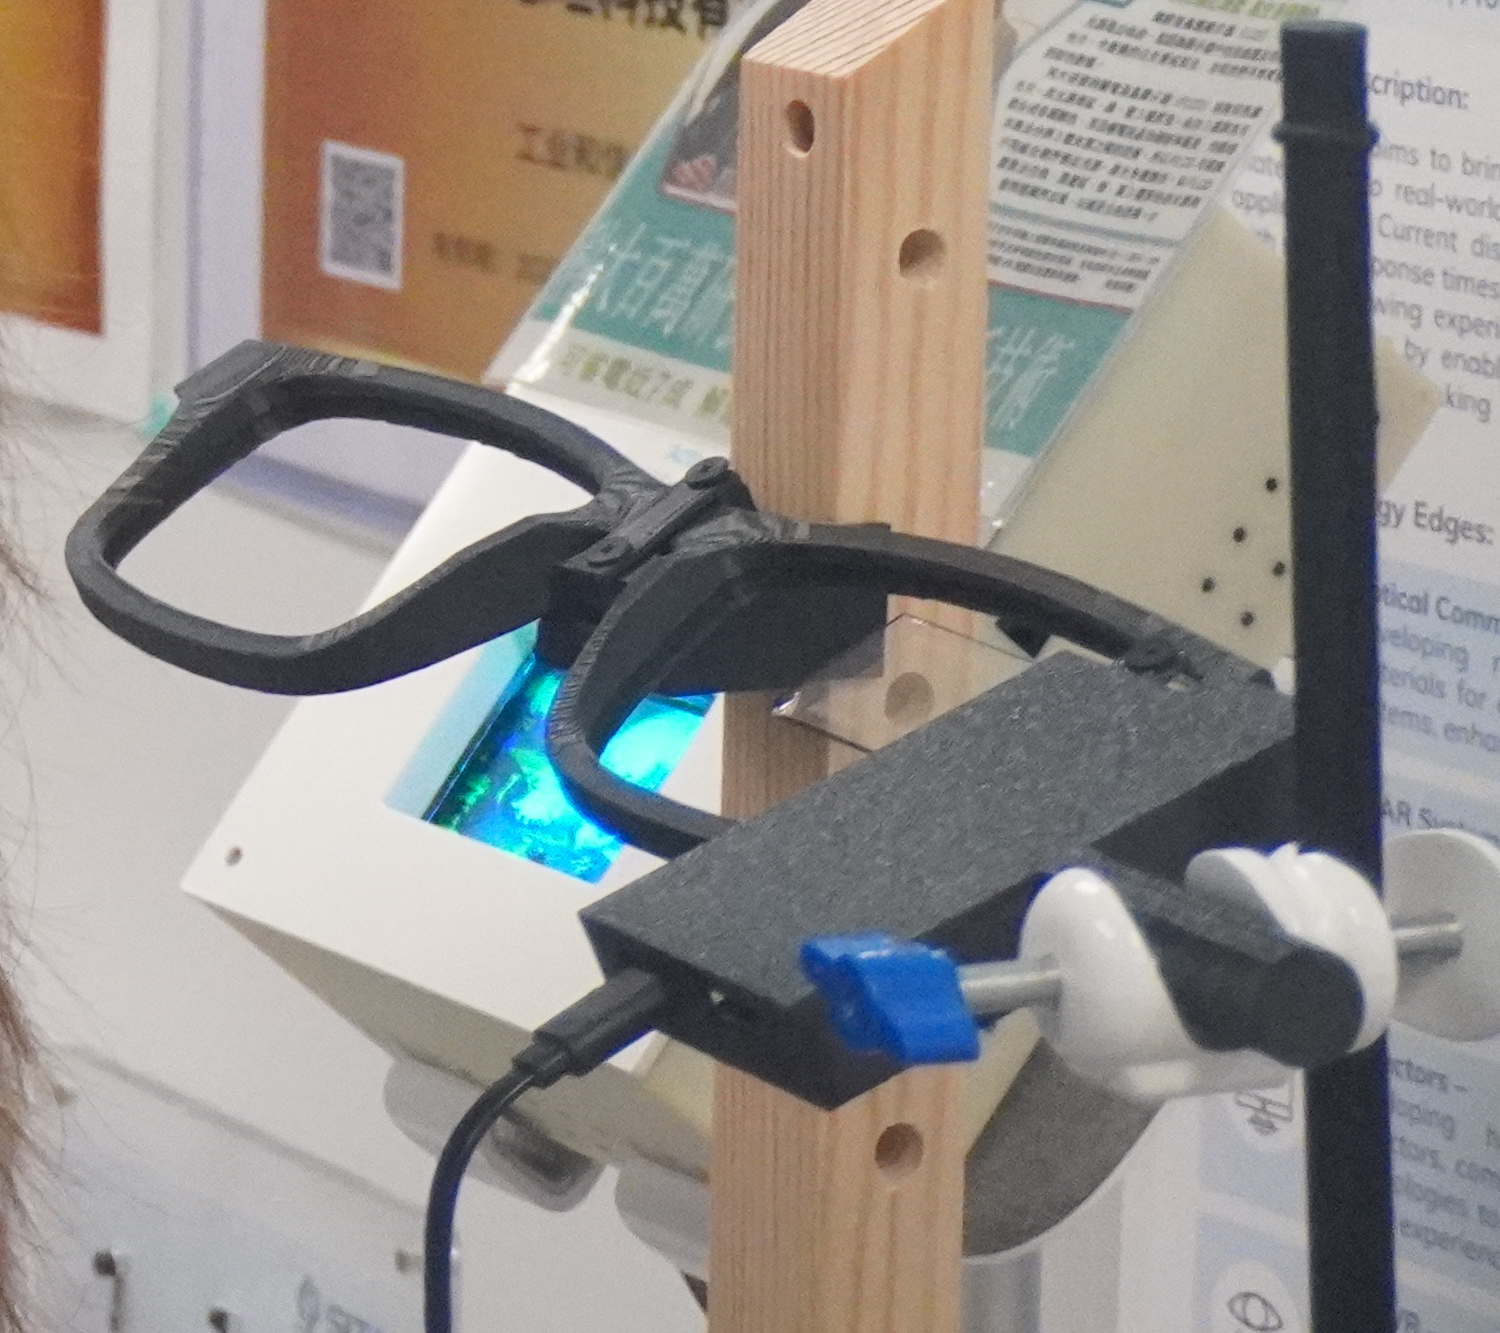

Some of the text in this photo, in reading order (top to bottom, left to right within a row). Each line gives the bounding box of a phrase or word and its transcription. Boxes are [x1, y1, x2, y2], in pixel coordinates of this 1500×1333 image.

[1367, 73, 1469, 110] cription:
[1444, 383, 1492, 424] king
[1414, 500, 1494, 546] Edges:
[1382, 586, 1429, 616] tical
